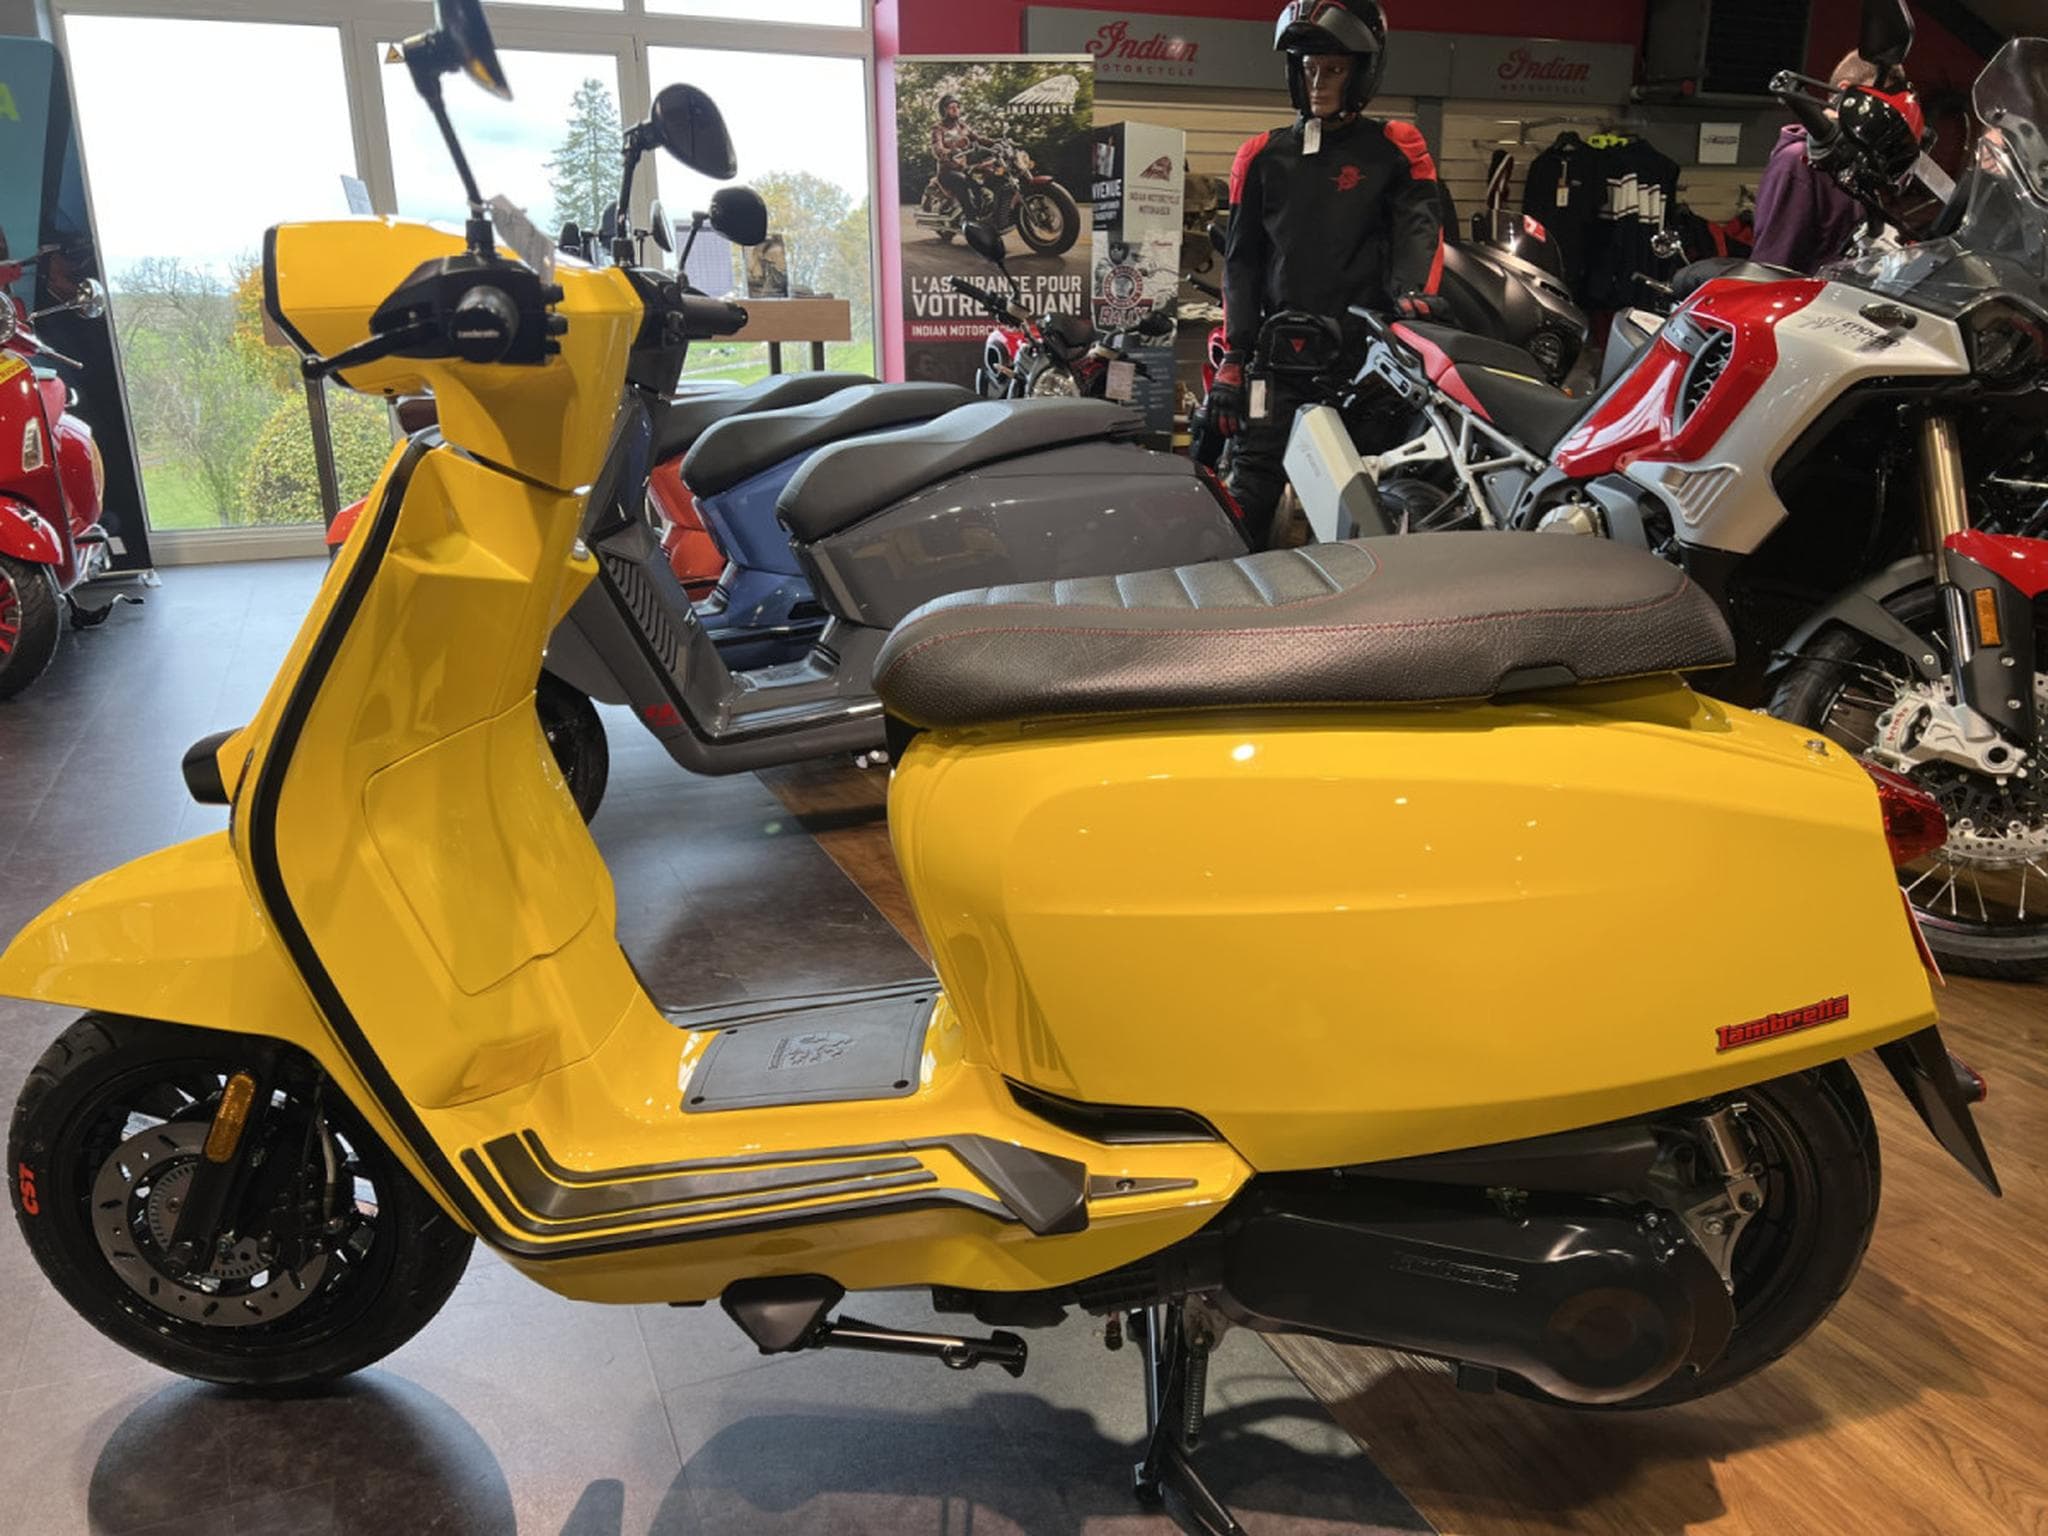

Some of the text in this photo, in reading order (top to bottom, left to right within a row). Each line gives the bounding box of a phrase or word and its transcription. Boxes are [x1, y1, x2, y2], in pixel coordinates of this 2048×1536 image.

[1085, 19, 1199, 63] Indian
[1095, 62, 1194, 77] OTORCYCLE
[1497, 48, 1590, 81] Indian
[1036, 276, 1082, 293] POUR
[912, 294, 989, 317] VOTRE
[911, 325, 947, 337] INDIAN
[1716, 995, 1849, 1052] Lambretta
[19, 1161, 40, 1215] CST
